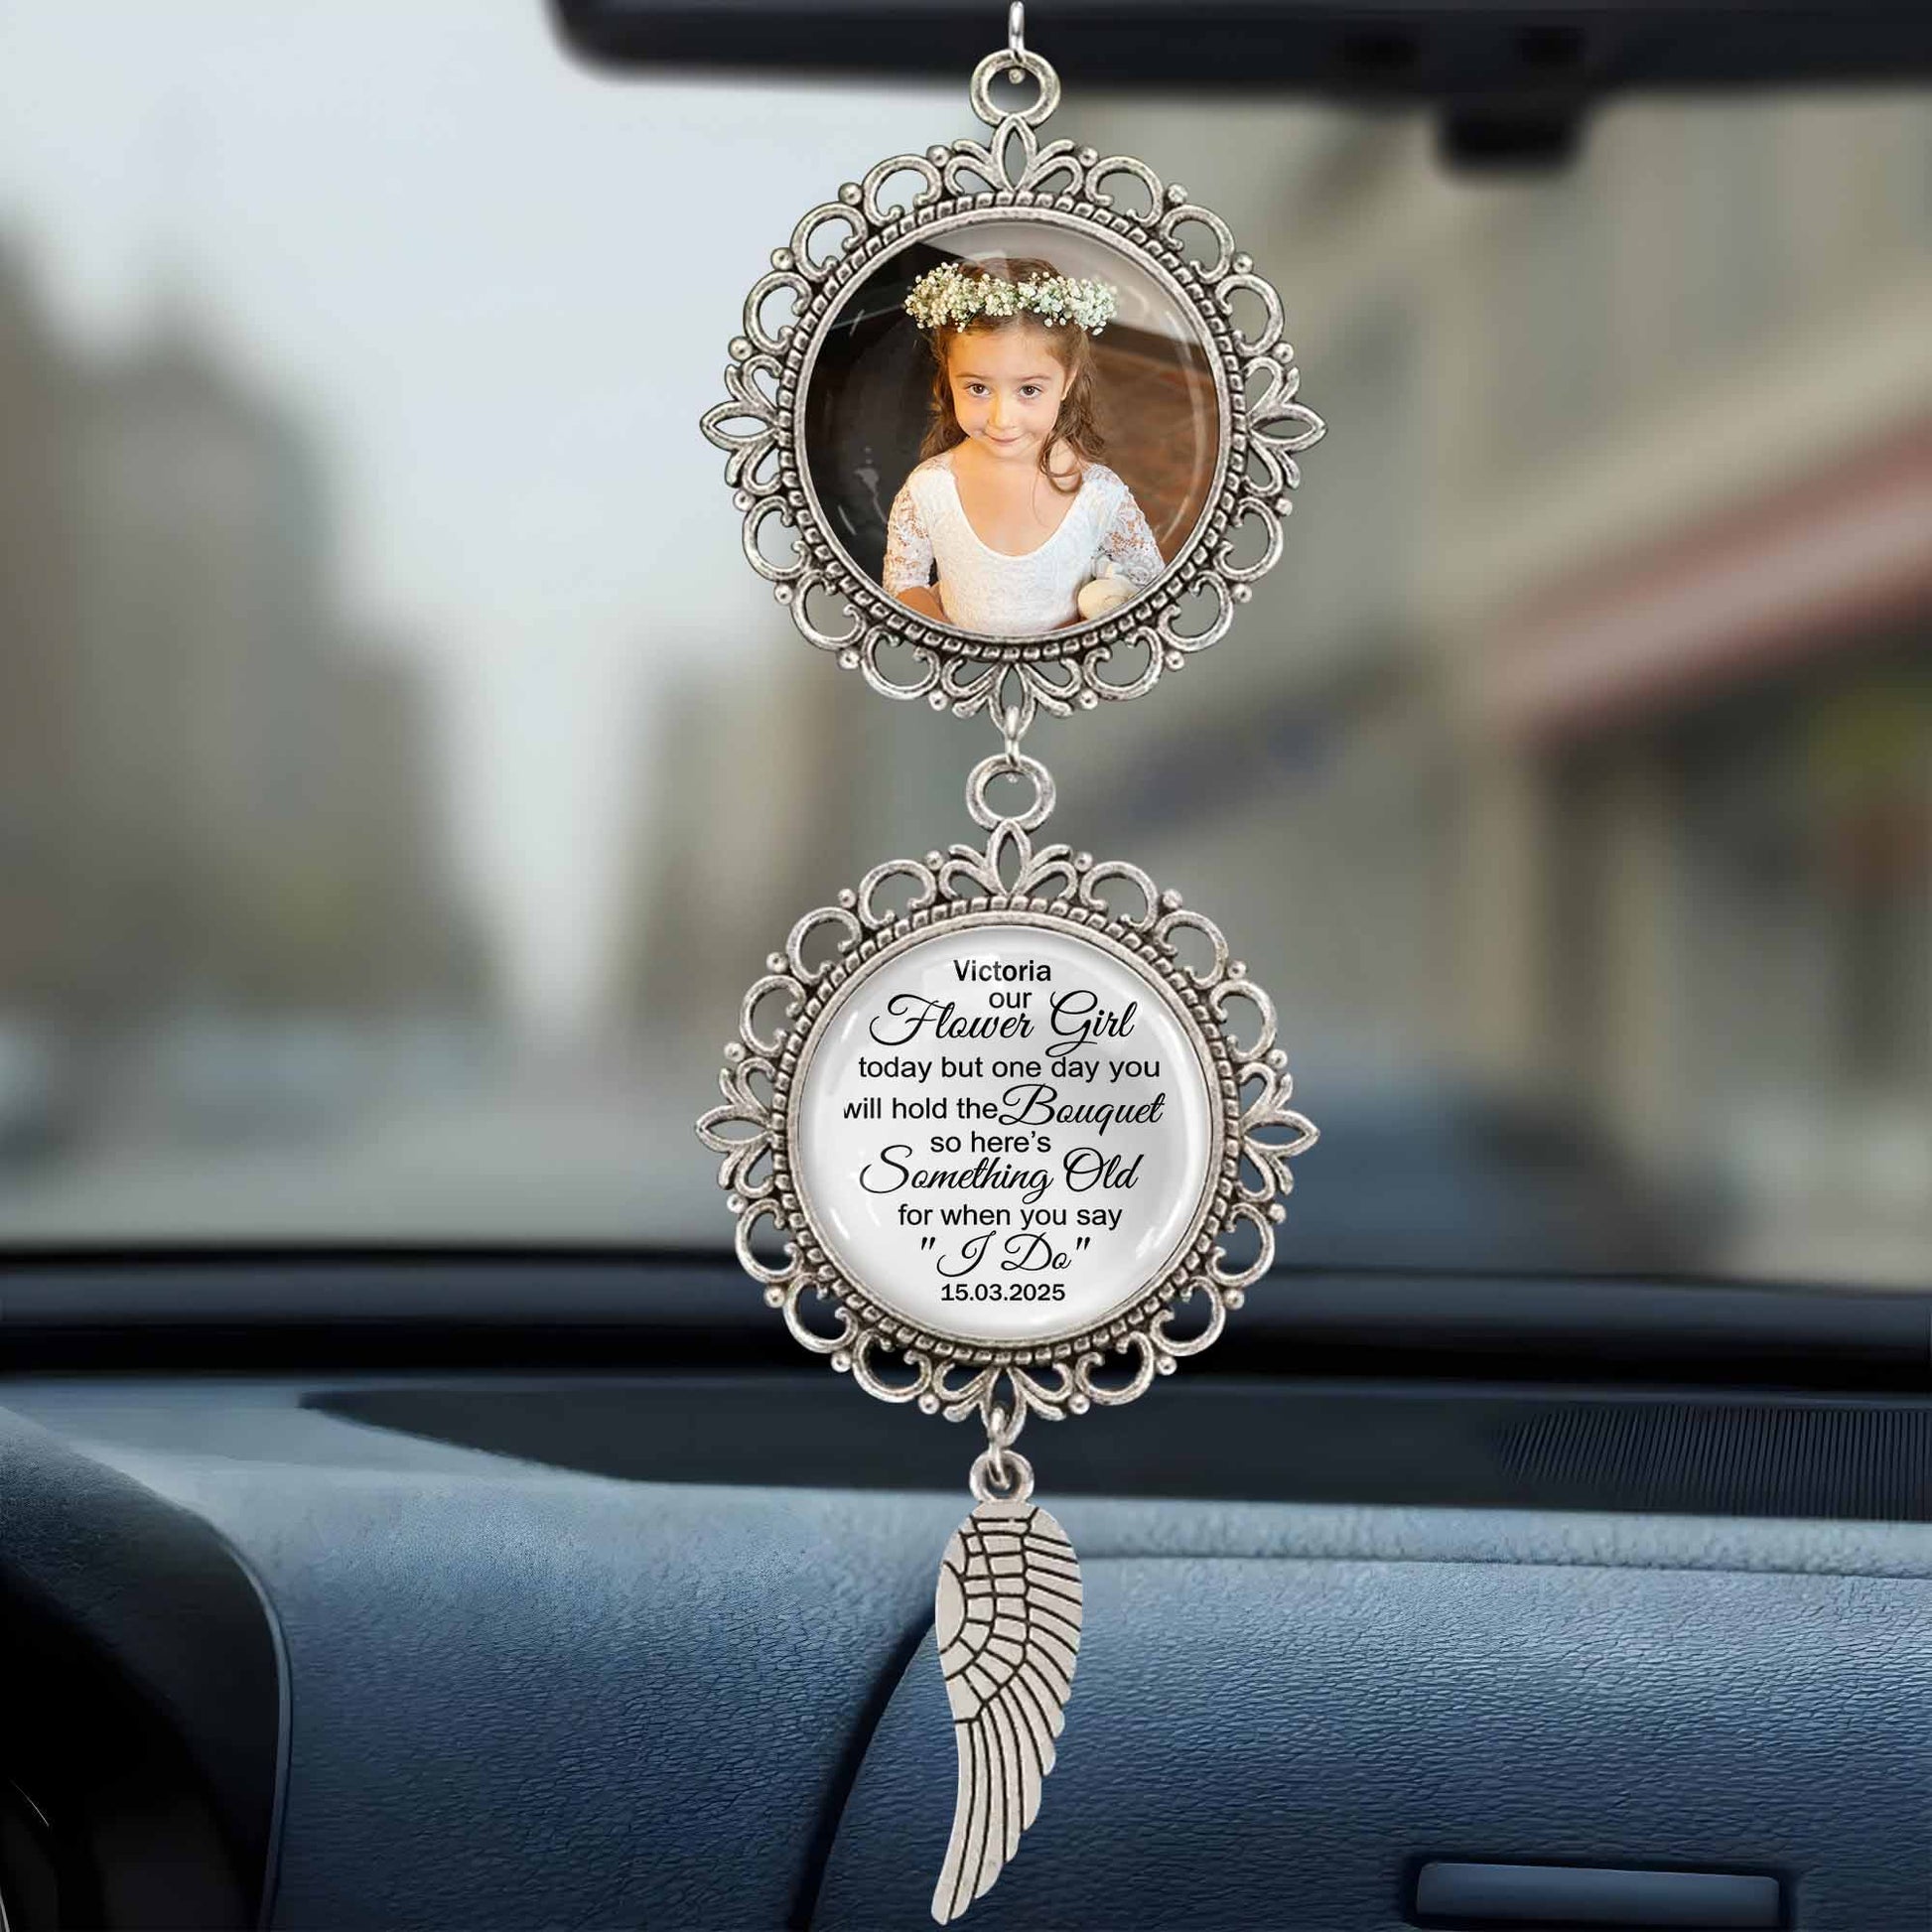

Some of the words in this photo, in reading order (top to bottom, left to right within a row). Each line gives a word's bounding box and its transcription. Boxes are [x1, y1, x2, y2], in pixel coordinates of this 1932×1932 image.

[953, 959, 1052, 982] Victoria
[989, 992, 1033, 1009] our
[869, 993, 1034, 1046] Flower
[1045, 990, 1138, 1057] Girl
[859, 1056, 931, 1083] today
[942, 1056, 983, 1078] but
[992, 1060, 1040, 1078] one
[1051, 1056, 1099, 1083] day
[1109, 1061, 1160, 1083] you
[843, 1097, 882, 1119] will
[893, 1097, 947, 1119] hold
[957, 1097, 998, 1119] the
[999, 1083, 1166, 1136] Bouquet
[930, 1135, 961, 1153] so
[971, 1131, 1051, 1153] here’s
[859, 1145, 1053, 1204] Something
[1063, 1147, 1145, 1192] Old
[897, 1204, 933, 1225] for
[940, 1204, 1010, 1225] when
[1020, 1209, 1066, 1230] you
[1076, 1209, 1122, 1230] say
[940, 1284, 1065, 1302] 15.03.2025
